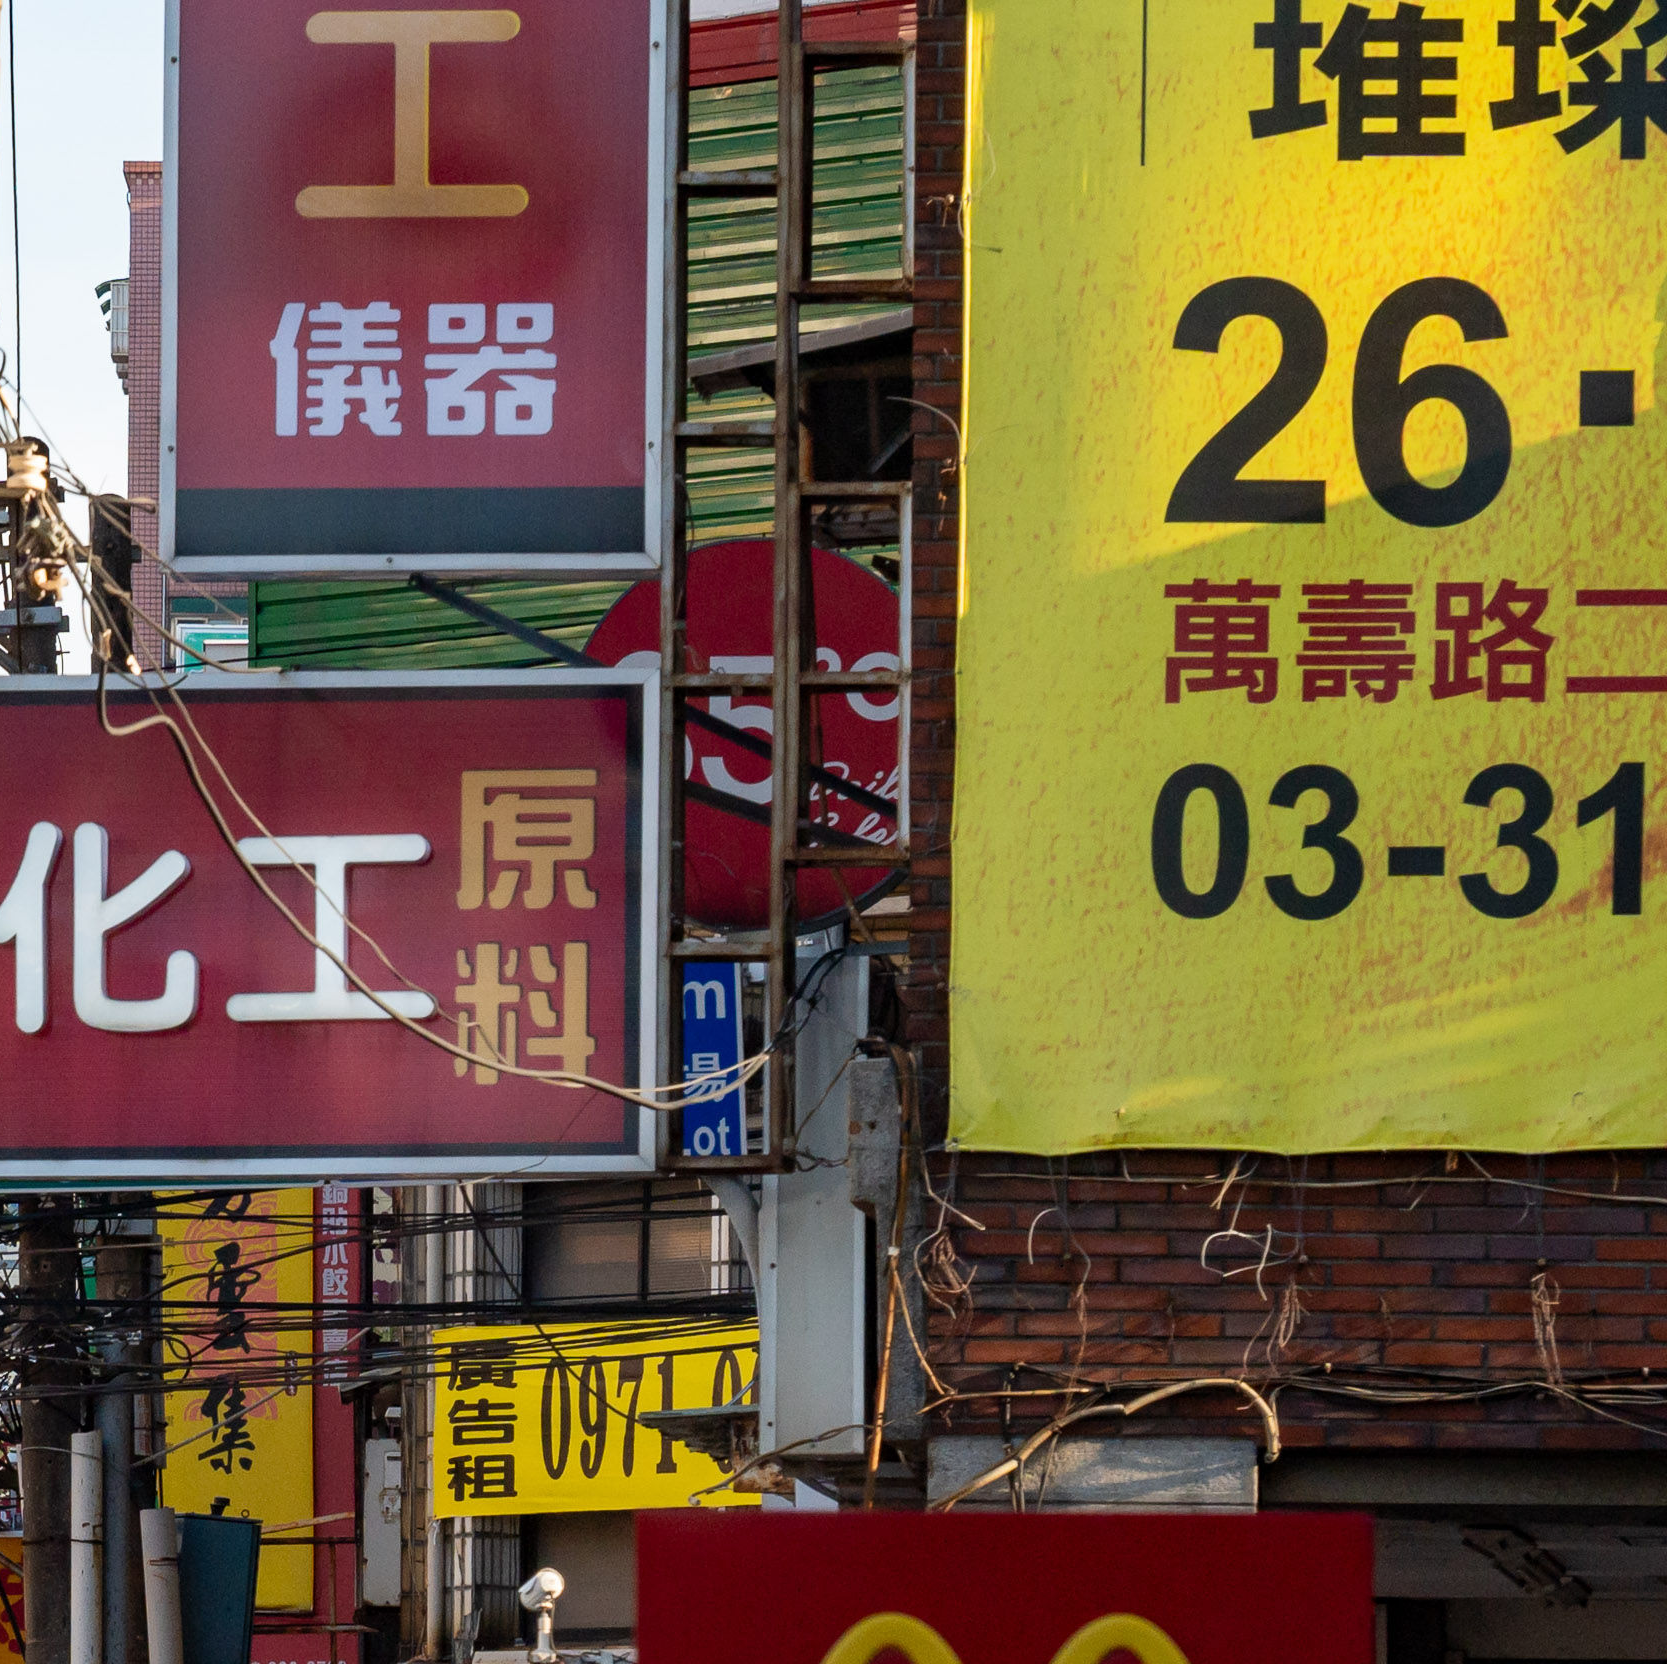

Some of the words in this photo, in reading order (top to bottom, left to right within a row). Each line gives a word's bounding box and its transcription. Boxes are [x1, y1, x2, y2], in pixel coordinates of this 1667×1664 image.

[295, 9, 528, 218] 工
[270, 300, 557, 438] 儀器
[1150, 762, 1646, 921] 03-31
[453, 768, 597, 1088] 原料
[448, 1341, 518, 1502] 廣告租
[541, 1354, 678, 1480] 0971
